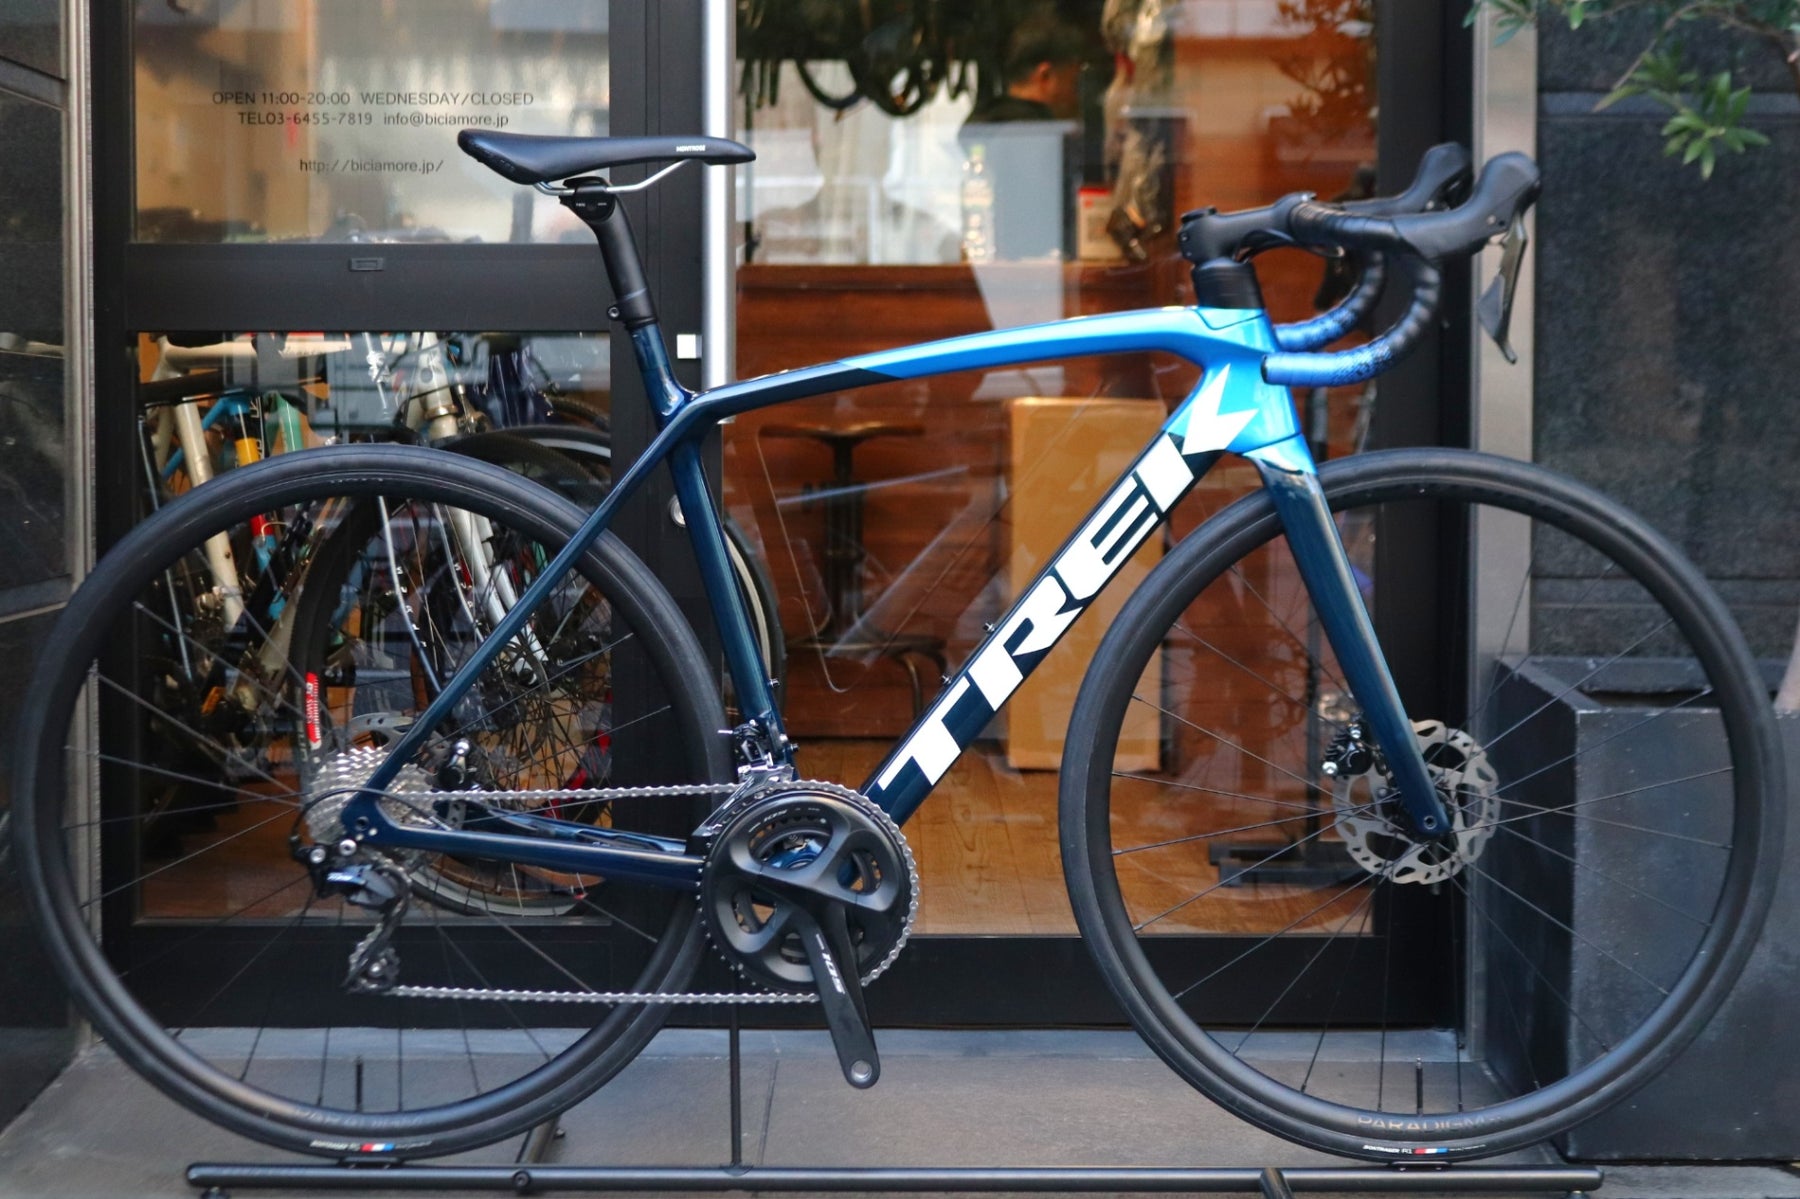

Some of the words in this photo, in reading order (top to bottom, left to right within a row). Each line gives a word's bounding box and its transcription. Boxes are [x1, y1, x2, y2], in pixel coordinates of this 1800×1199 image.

[212, 91, 256, 105] OPEN
[262, 91, 350, 105] 11:00-20:00
[361, 91, 534, 107] WEDNESDAY/CLOSED
[238, 111, 373, 126] TEL03-6455-7819
[383, 112, 509, 128] info@biciamore.jp
[299, 159, 444, 175] http://biciamore.jp/
[877, 363, 1259, 792] TREK
